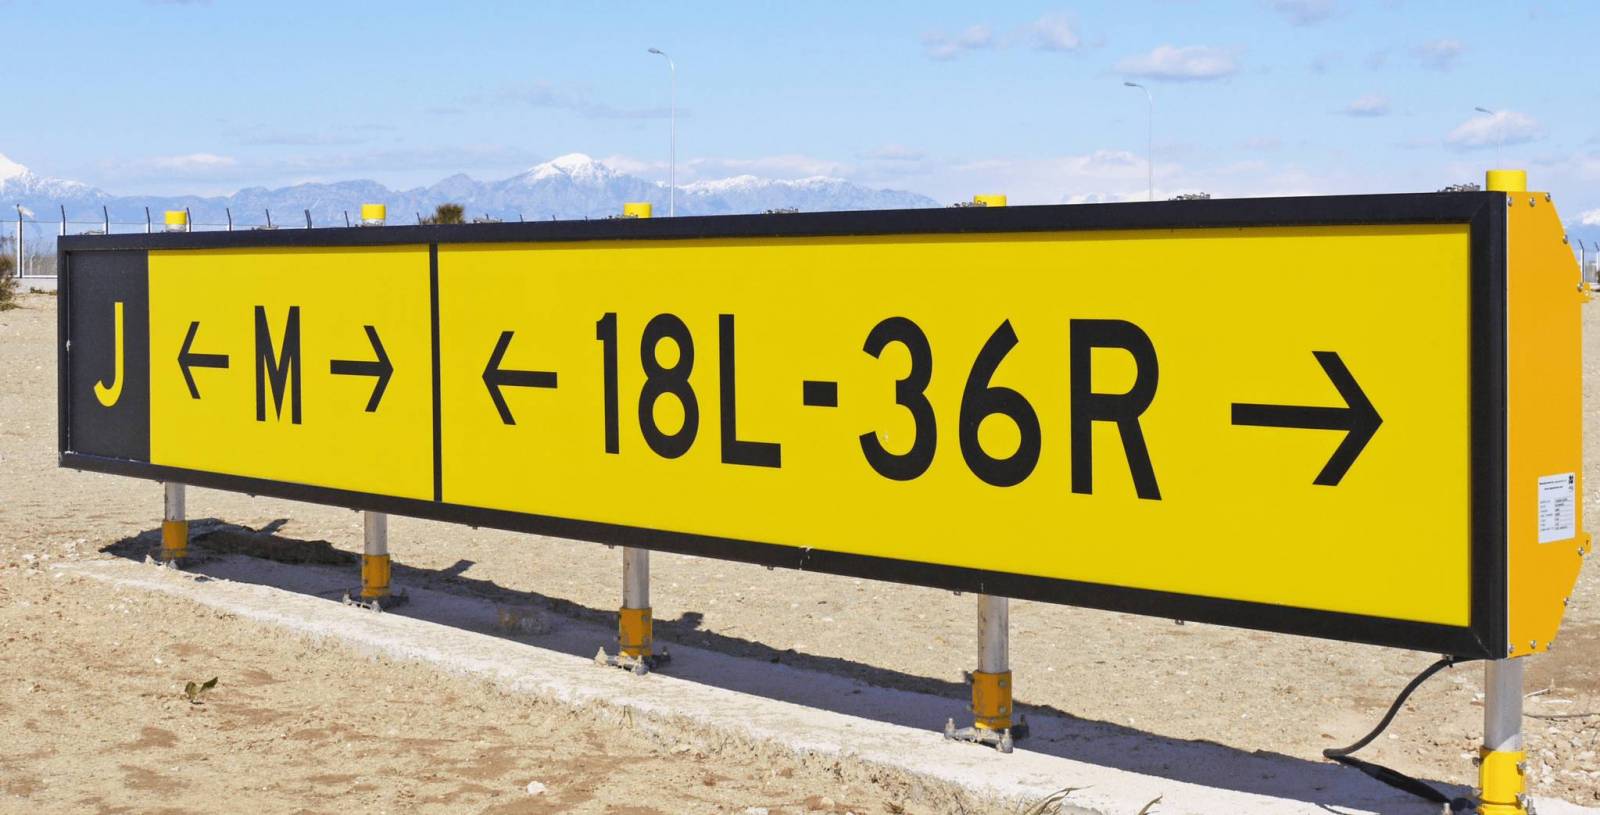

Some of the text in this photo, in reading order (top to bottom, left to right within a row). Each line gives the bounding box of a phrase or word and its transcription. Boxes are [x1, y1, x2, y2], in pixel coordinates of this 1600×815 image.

[94, 302, 123, 407] J
[255, 306, 301, 424] M
[597, 313, 1161, 500] 18L-36R
